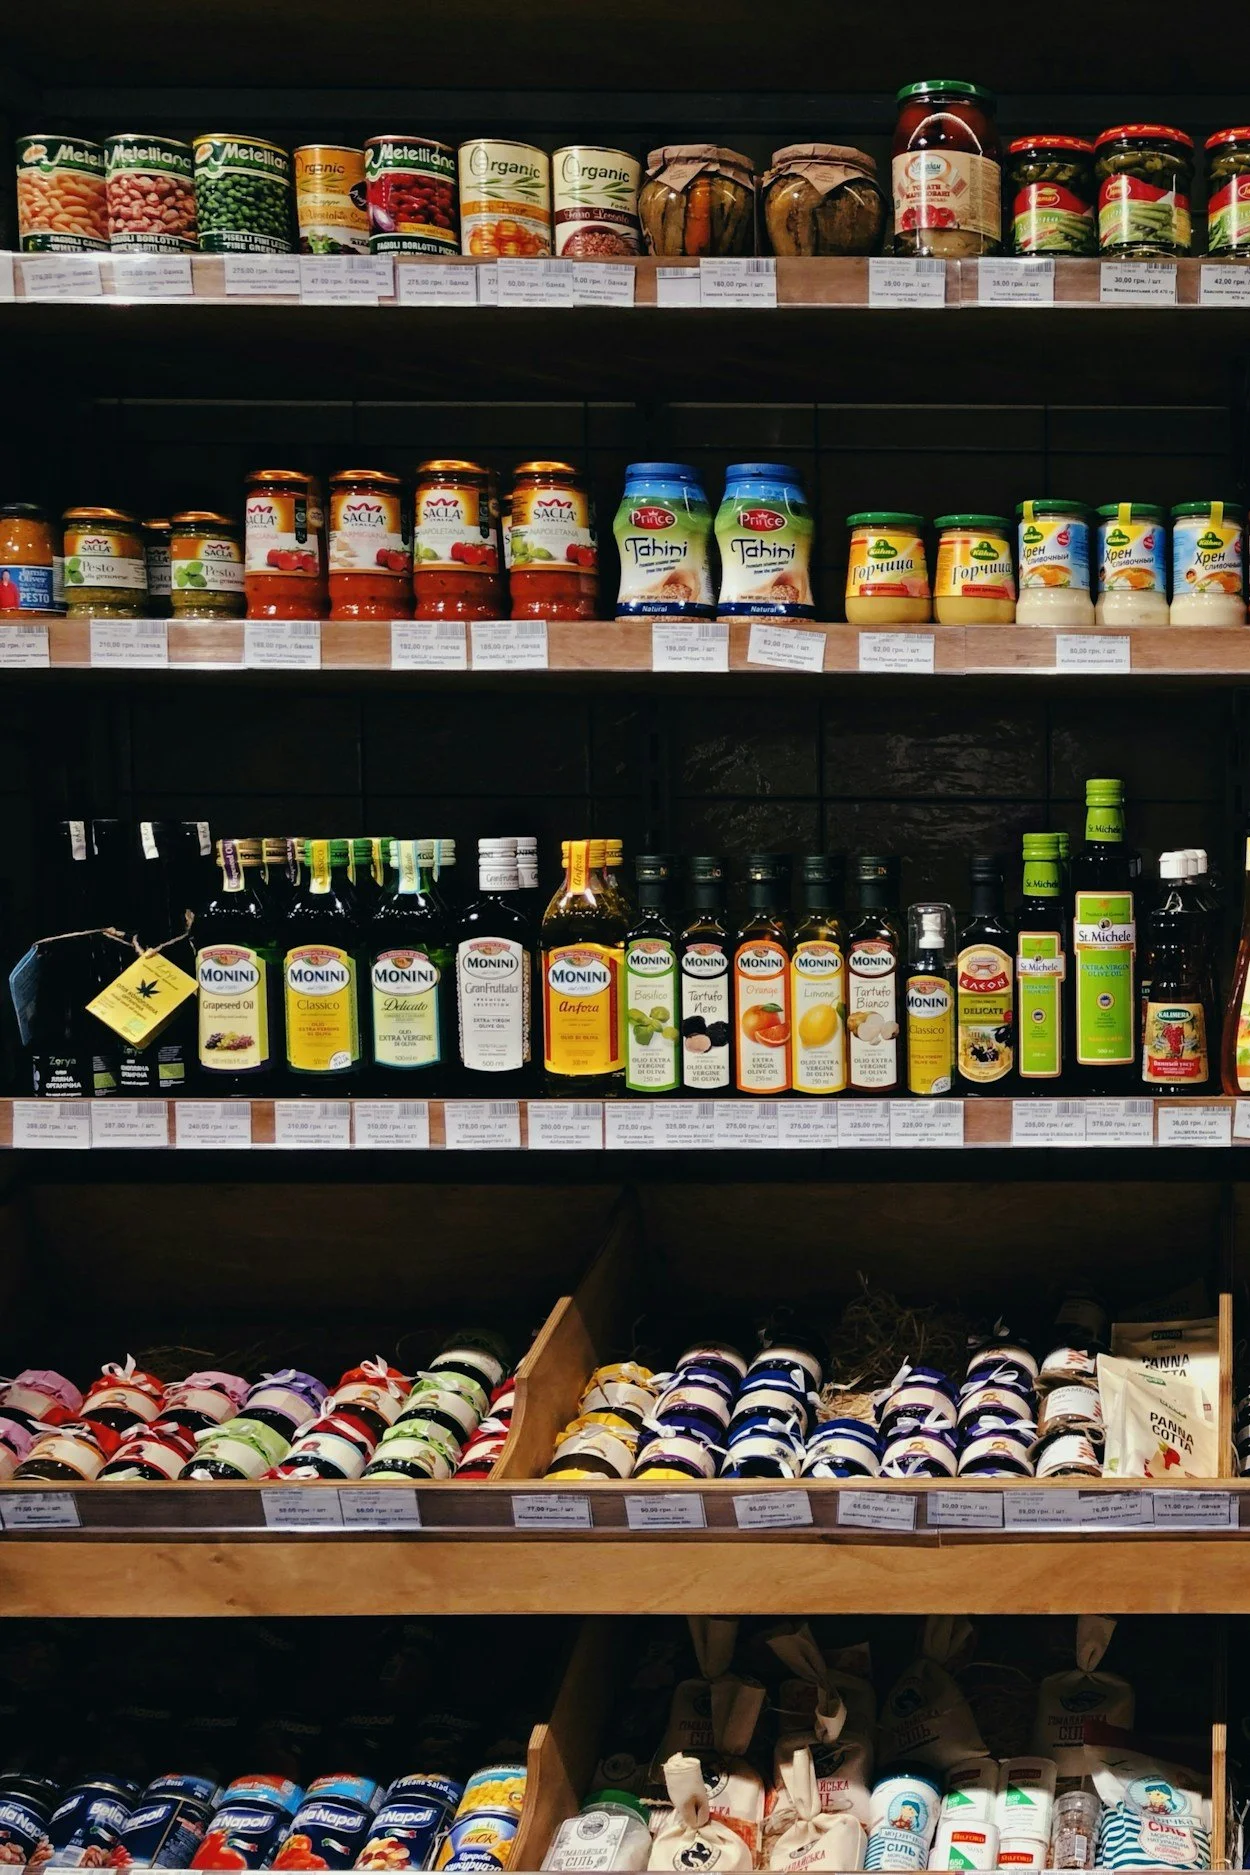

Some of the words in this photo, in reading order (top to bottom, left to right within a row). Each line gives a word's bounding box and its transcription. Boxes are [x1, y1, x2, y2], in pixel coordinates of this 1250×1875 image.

[106, 144, 191, 169] Metelliana
[372, 142, 455, 170] Metelliana
[469, 146, 540, 179] Organic
[562, 153, 630, 183] Organic
[136, 235, 179, 246] BORLOTTI
[222, 233, 252, 242] PISELLI
[254, 235, 270, 245] FINI
[377, 241, 399, 251] FAGIOLI
[402, 241, 437, 252] BORLOTTI
[1132, 278, 1146, 286] грн.
[1233, 279, 1248, 287] грн.
[630, 509, 677, 527] Prince
[740, 511, 785, 528] Prince
[1107, 536, 1130, 544] Kühne
[1199, 539, 1223, 547] Kühne
[625, 537, 688, 558] Tahini
[731, 539, 796, 559] Tahini
[868, 547, 898, 558] Kühne
[1022, 545, 1046, 562] Хрен
[971, 548, 999, 560] Kühne
[1105, 548, 1132, 563] Хрен
[1196, 552, 1225, 564] Хрен
[82, 561, 114, 573] Pesto
[1112, 557, 1154, 568] сливочный
[205, 565, 235, 578] Pesto
[852, 559, 914, 582] Горчица
[20, 592, 50, 604] PESTO
[642, 605, 668, 613] Natural
[751, 605, 777, 613] Natural
[467, 957, 514, 969] MONINI
[630, 954, 671, 966] MONINI
[685, 956, 725, 967] MONINI
[740, 957, 783, 968] MONINI
[798, 957, 838, 968] MONINI
[852, 956, 892, 966] MONINI
[200, 968, 255, 982] MONINI
[290, 968, 346, 982] MONINI
[374, 968, 435, 984] MONINI
[552, 969, 607, 984] MONINI
[465, 981, 519, 995] GranFruttato
[746, 984, 778, 998] Orange
[803, 988, 835, 999] Limone
[855, 986, 891, 998] Tartufo
[633, 989, 668, 1001] Basilico
[688, 991, 722, 1002] Tartufo
[202, 1001, 240, 1013] Grapeseed
[242, 1001, 254, 1011] Oil
[297, 999, 340, 1011] Classico
[382, 999, 428, 1012] Delicato
[558, 1001, 600, 1014] Anfora
[694, 1002, 718, 1014] Nero
[855, 998, 889, 1009] Bianco
[906, 996, 948, 1008] MONINI
[964, 1007, 1004, 1015] DELICATE
[1157, 1011, 1189, 1020] KALIMERA
[1149, 1411, 1195, 1447] PANNA
[1152, 1424, 1193, 1455] COTTA
[887, 1842, 917, 1857] СІЛЬ
[566, 1854, 594, 1867] СІЛЬ
